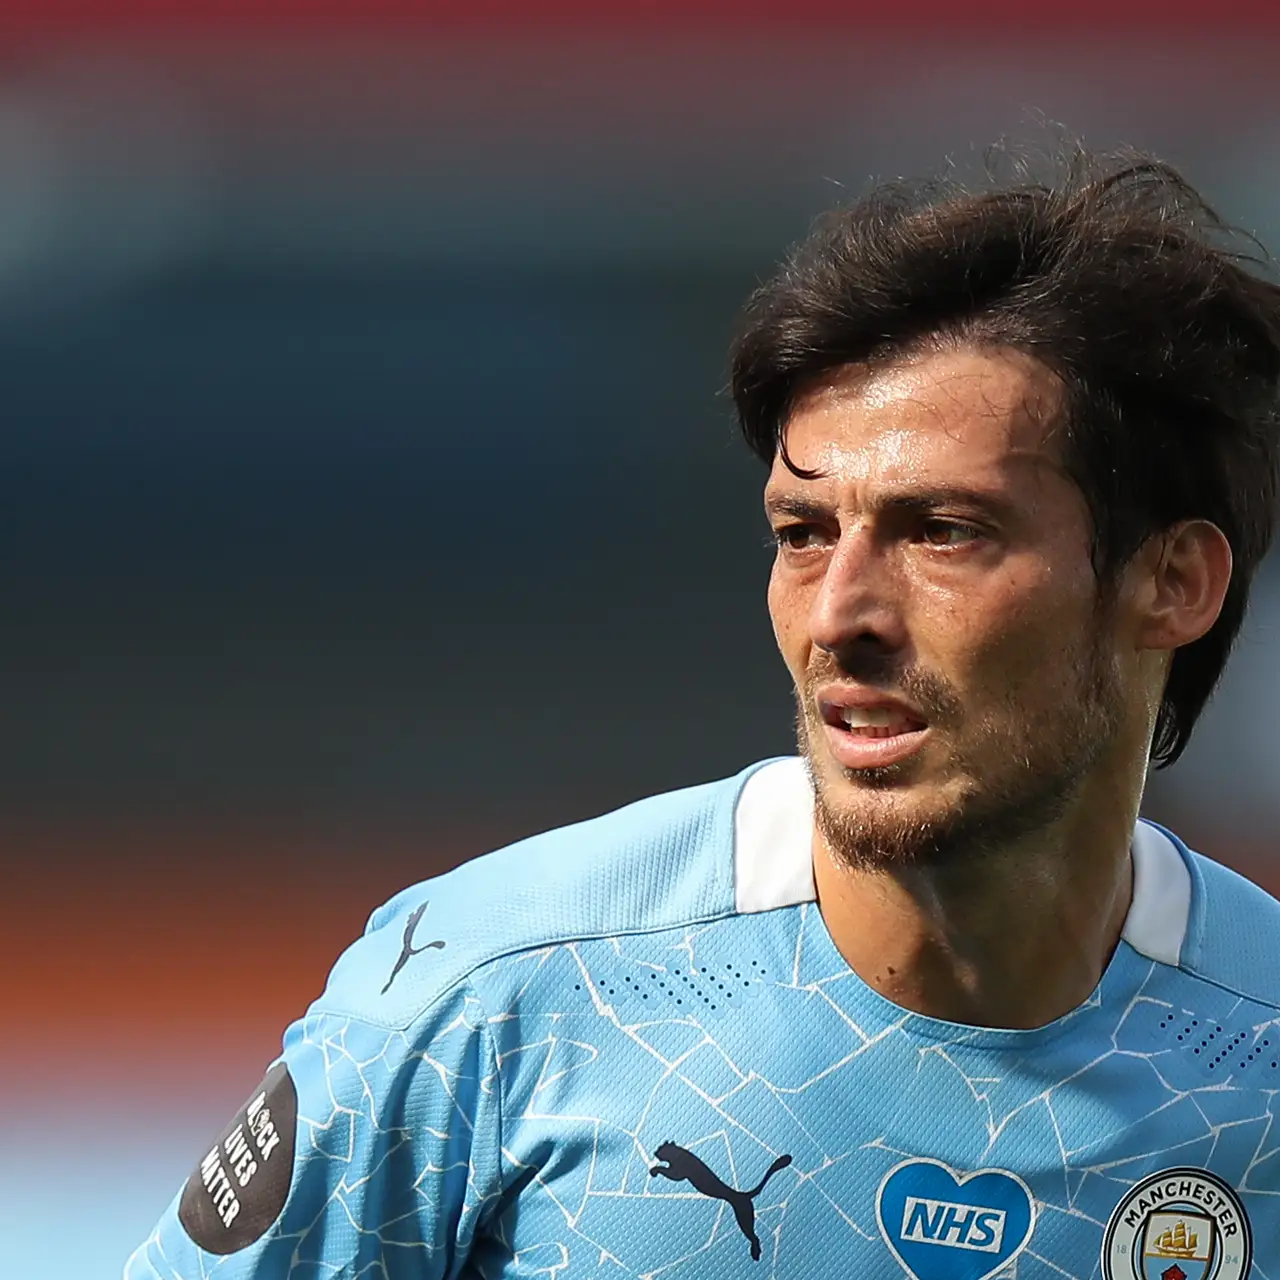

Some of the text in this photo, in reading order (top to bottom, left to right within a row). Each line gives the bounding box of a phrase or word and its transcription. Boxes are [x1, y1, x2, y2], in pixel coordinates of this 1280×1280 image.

[224, 1123, 258, 1188] LIVES
[200, 1144, 241, 1229] MATTER
[1124, 1180, 1238, 1238] MANCHESTER
[905, 1202, 1000, 1247] NHS
[1115, 1243, 1128, 1255] 18
